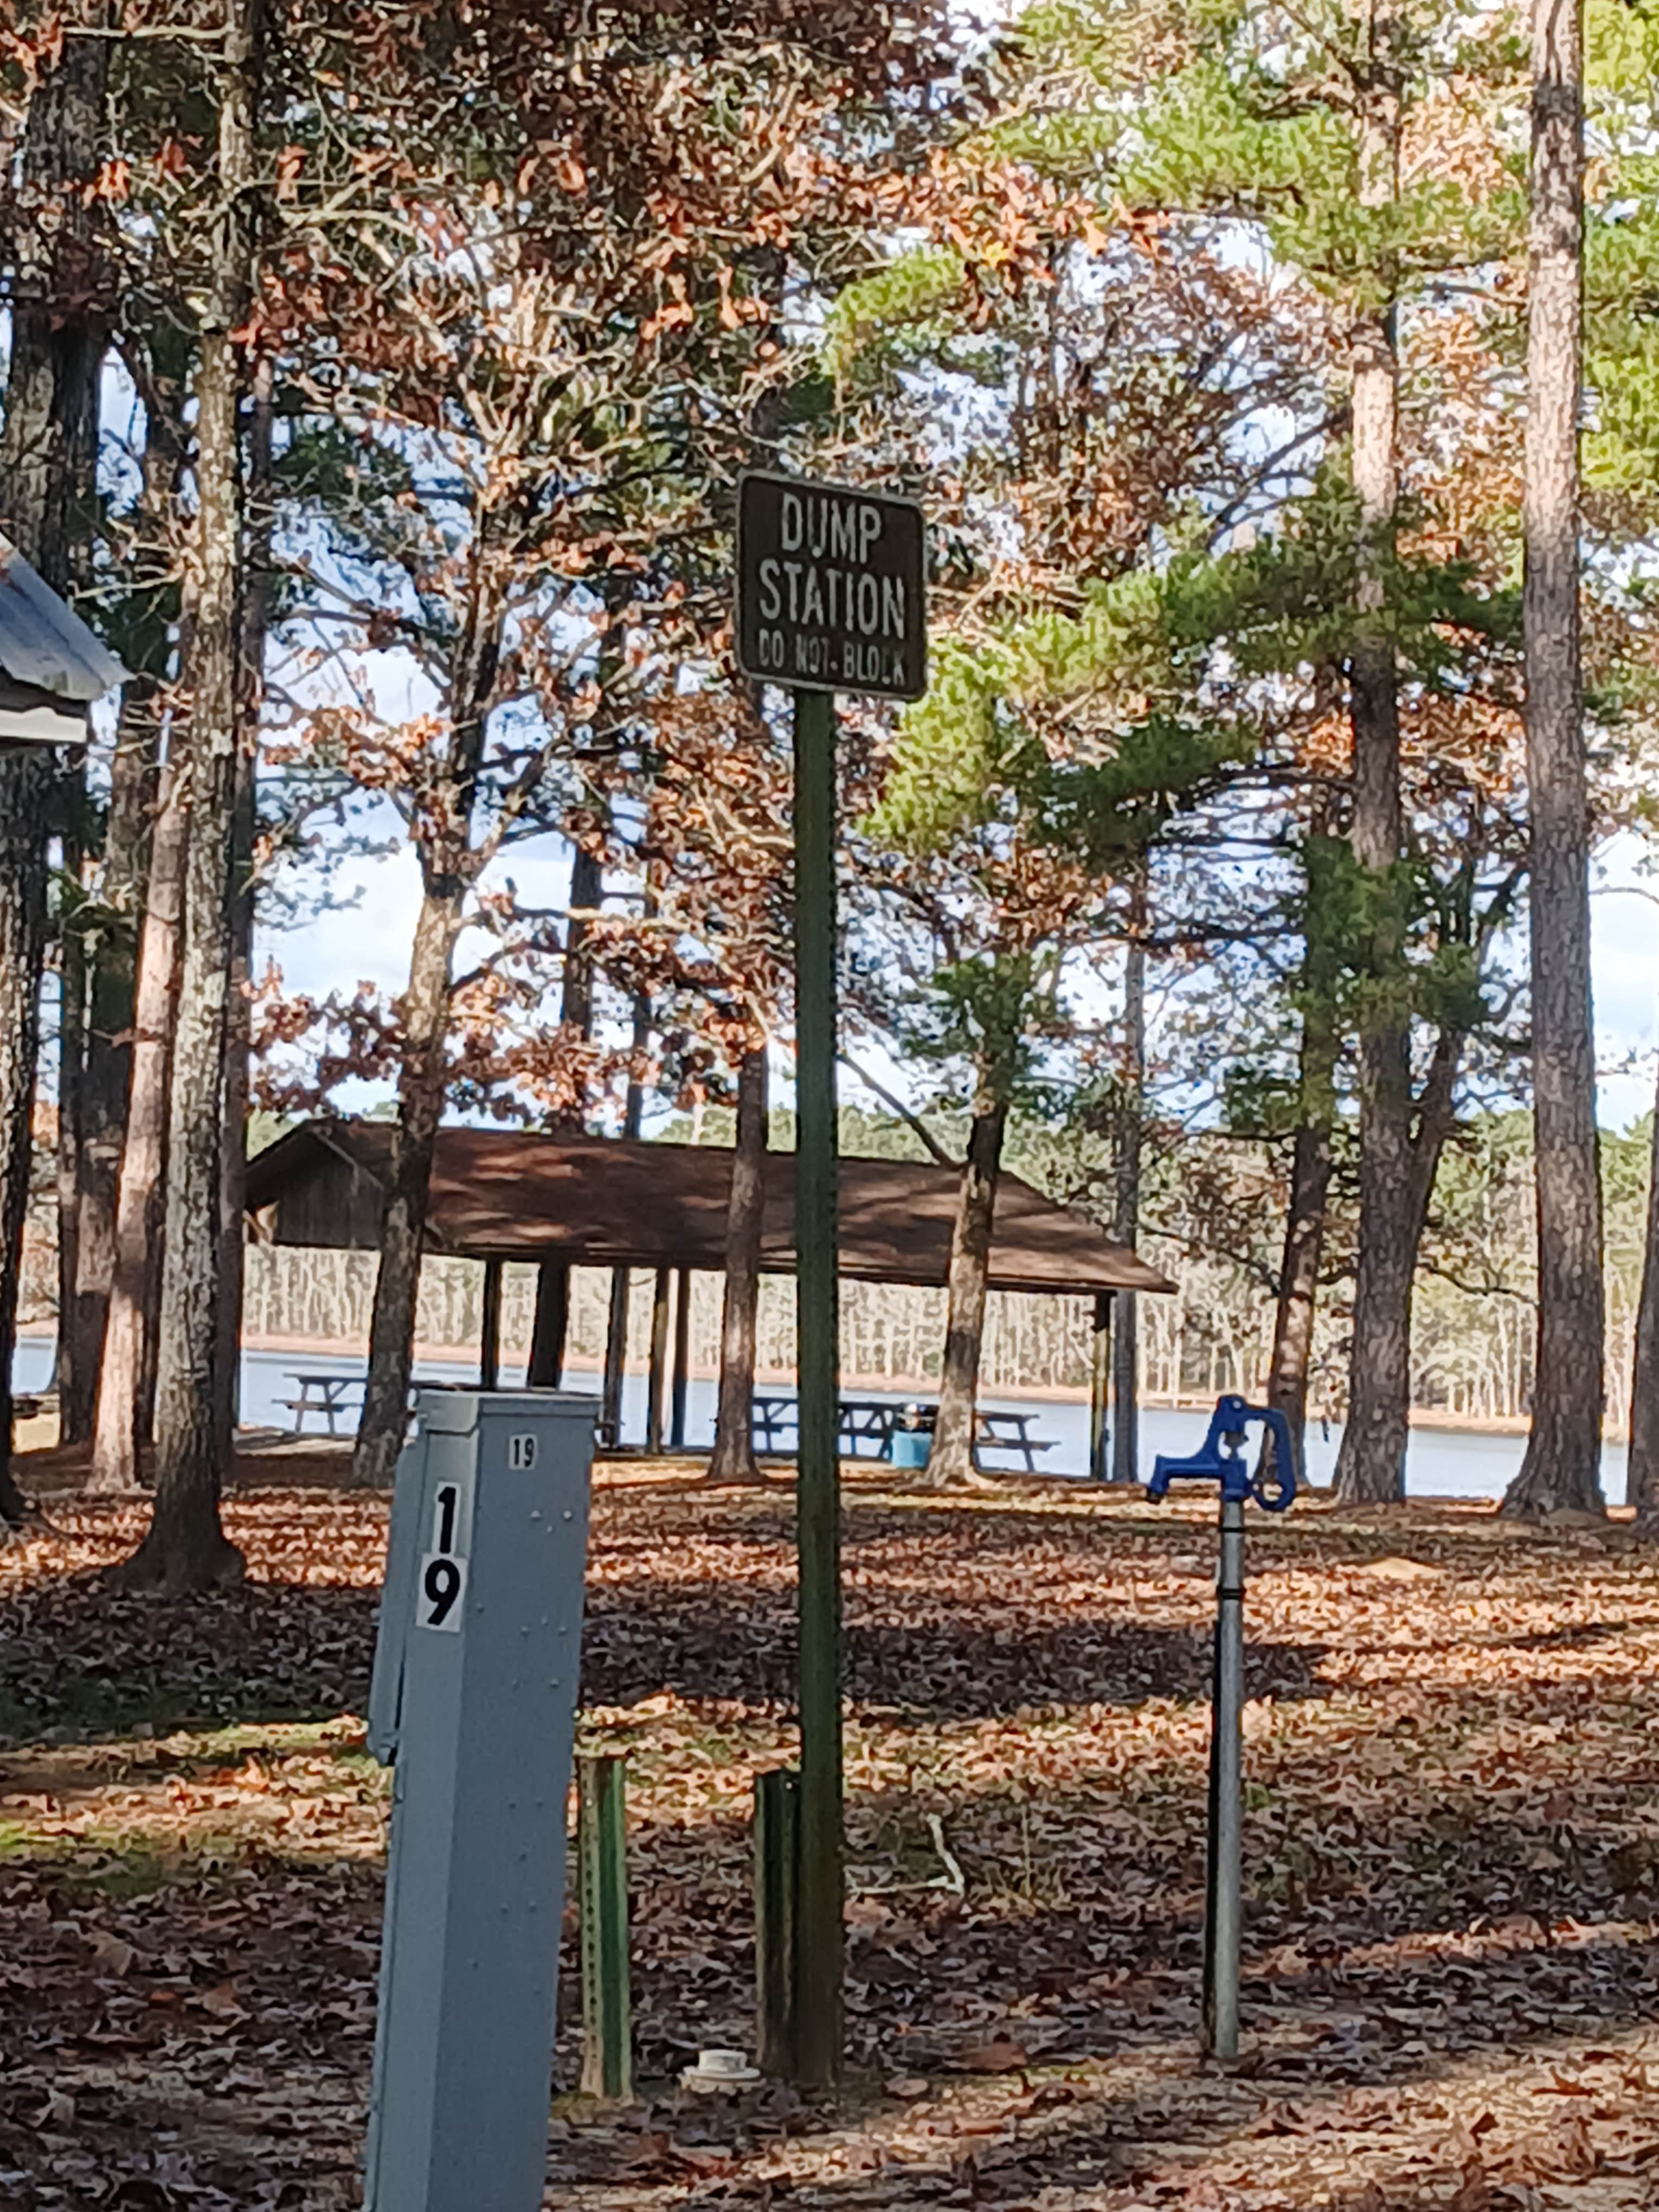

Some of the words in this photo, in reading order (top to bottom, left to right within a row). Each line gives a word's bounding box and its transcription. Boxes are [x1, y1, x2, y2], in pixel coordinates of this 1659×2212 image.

[781, 492, 882, 563] DUMP
[760, 558, 905, 639] STATION
[759, 628, 785, 668] DO
[795, 633, 829, 674] NOT
[513, 1438, 535, 1467] 19
